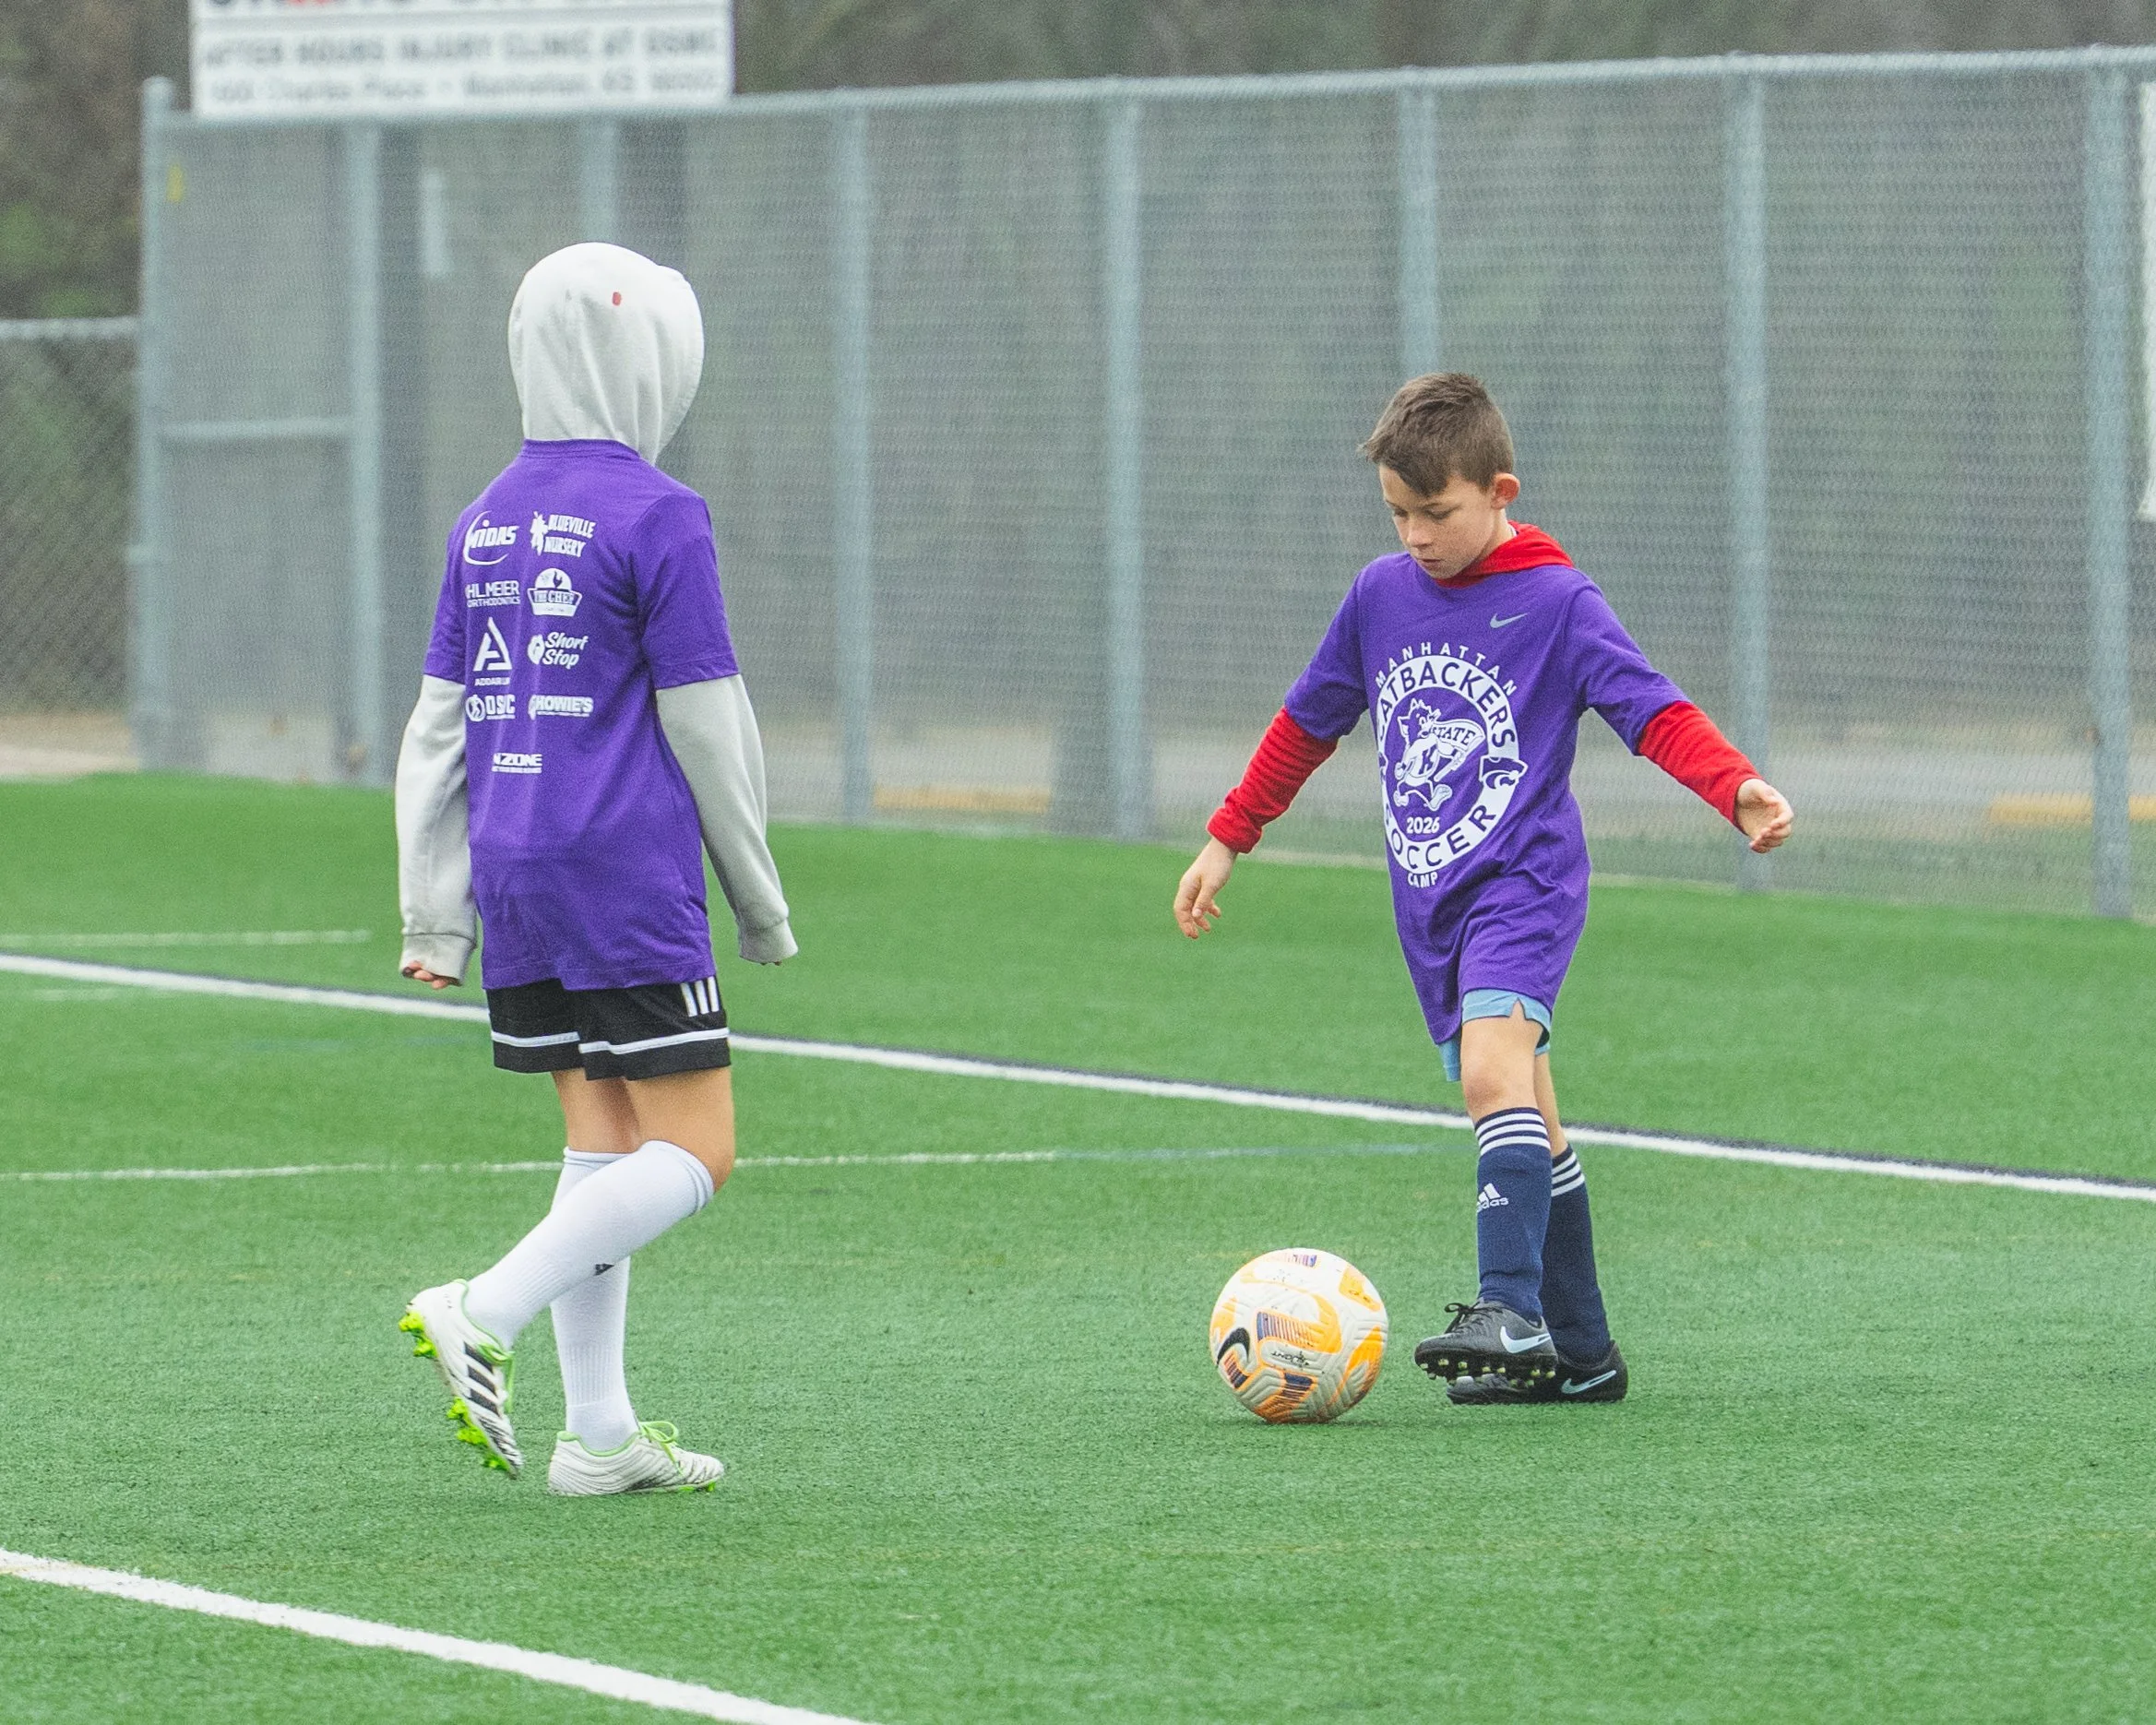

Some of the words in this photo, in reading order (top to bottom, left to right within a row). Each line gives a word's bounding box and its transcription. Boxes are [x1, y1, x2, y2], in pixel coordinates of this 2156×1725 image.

[544, 631, 589, 650] Short
[542, 648, 579, 670] Stop
[1375, 641, 1518, 696] MANHATTAN
[1406, 815, 1441, 835] 2026
[1407, 871, 1439, 889] CAMP
